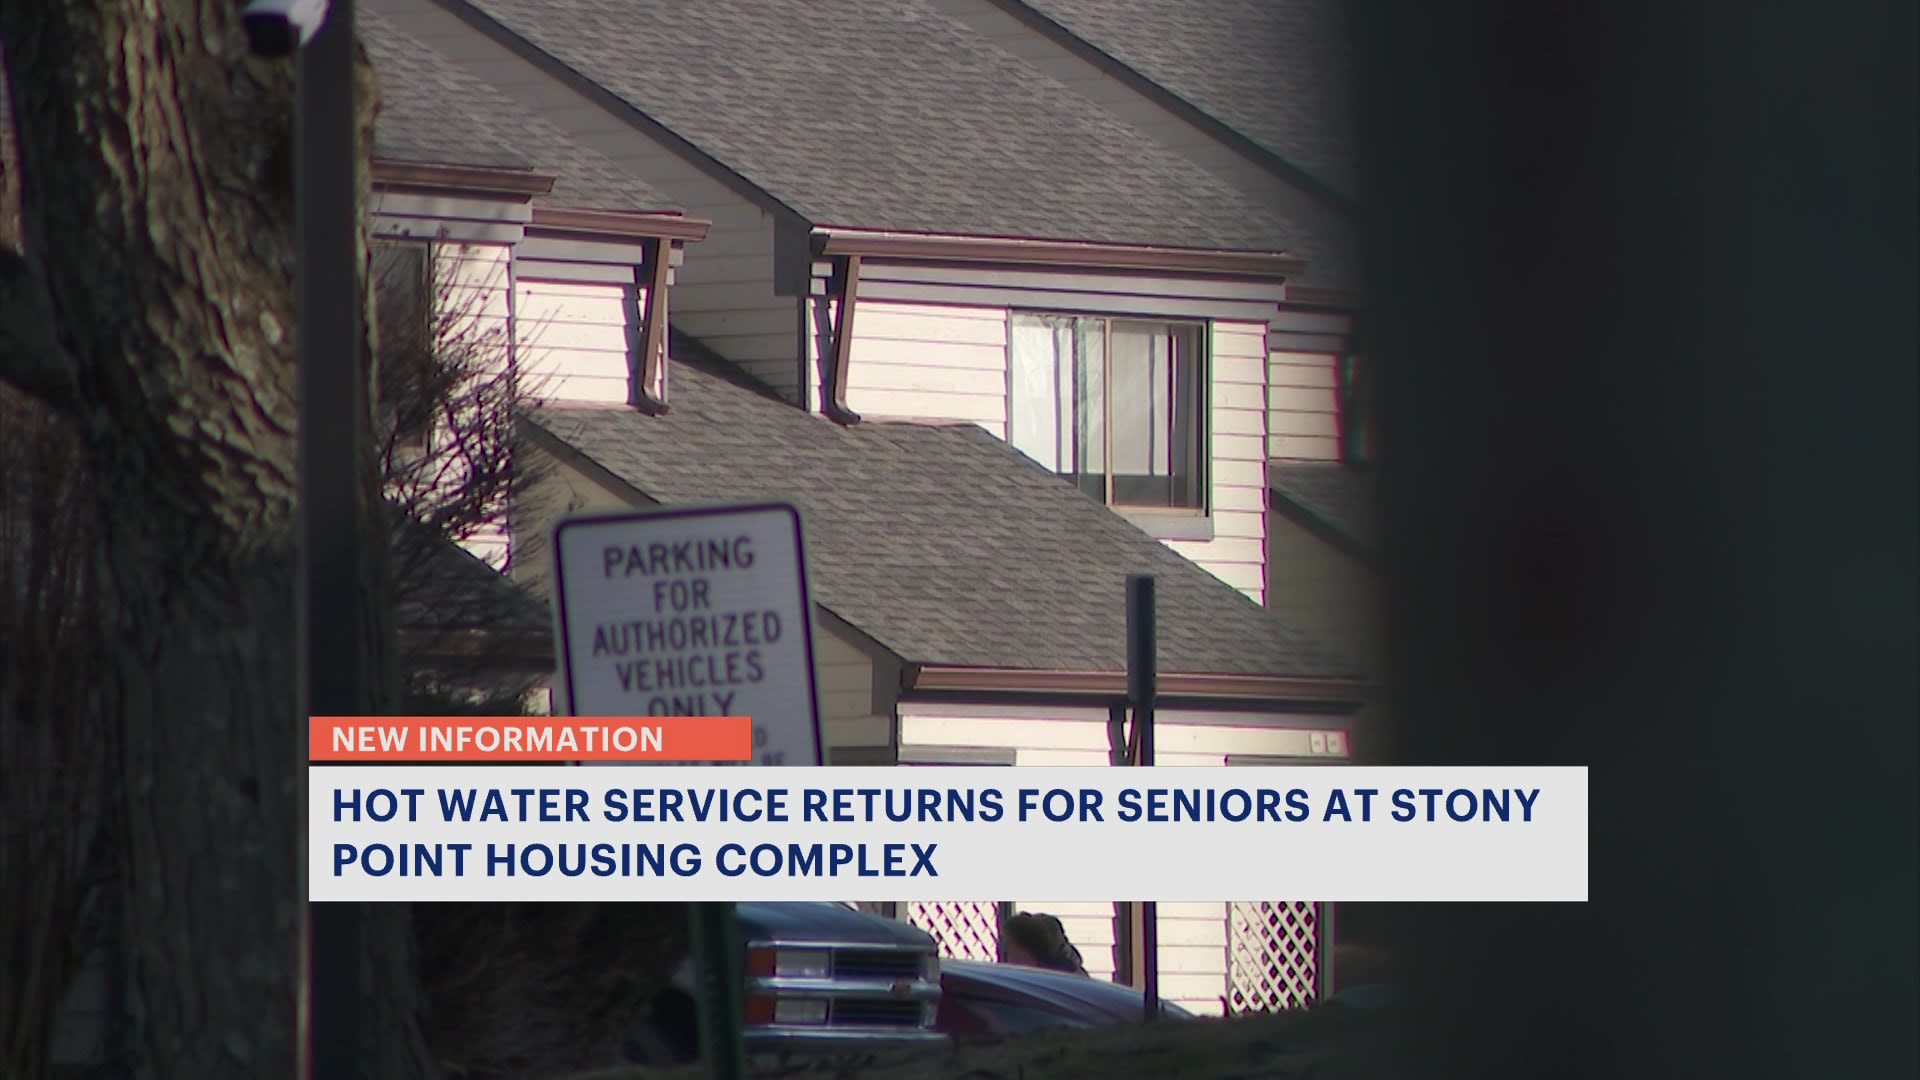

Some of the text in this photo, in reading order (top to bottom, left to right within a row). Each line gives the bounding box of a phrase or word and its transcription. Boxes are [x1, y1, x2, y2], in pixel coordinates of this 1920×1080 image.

[603, 536, 755, 579] PARKING
[653, 578, 711, 613] FOR
[593, 611, 782, 657] AUTHORIZED
[615, 652, 764, 692] VEHICLES
